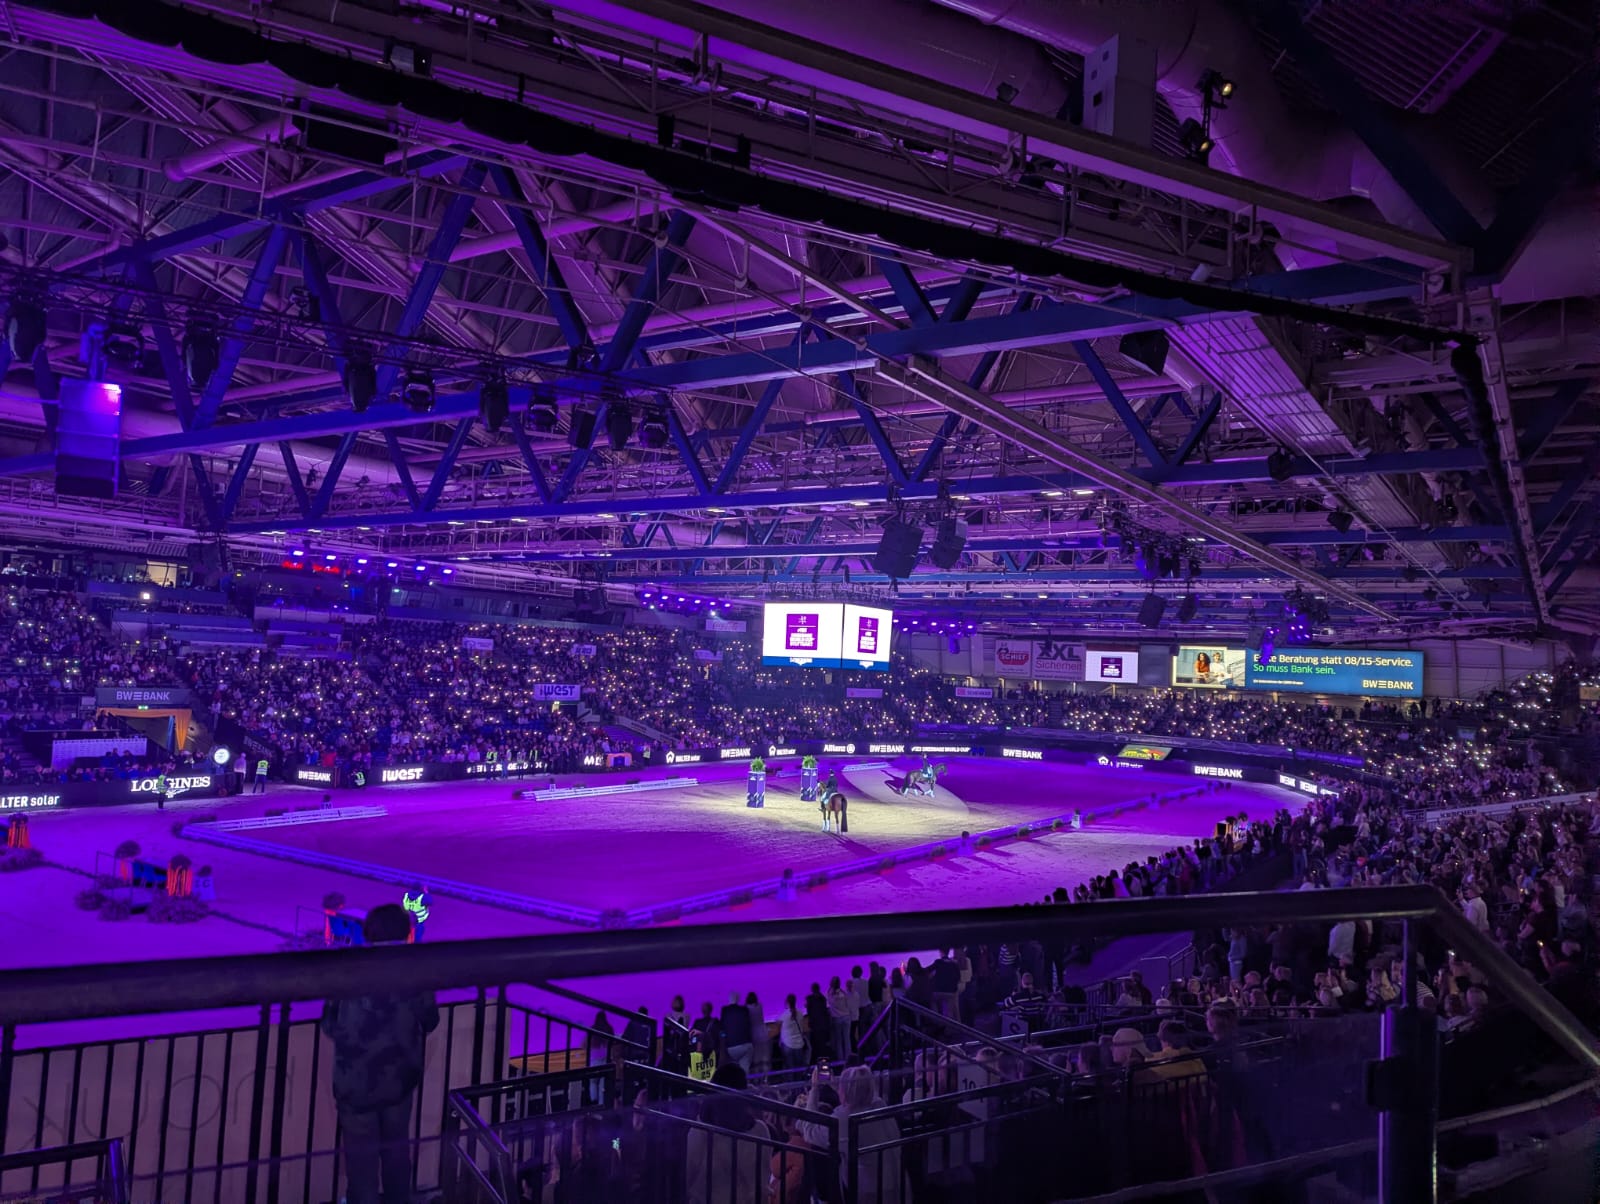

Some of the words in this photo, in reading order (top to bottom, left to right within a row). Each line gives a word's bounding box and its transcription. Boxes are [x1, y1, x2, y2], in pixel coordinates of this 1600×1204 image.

[1279, 654, 1319, 665] Beratung
[1321, 656, 1342, 665] statt
[1344, 656, 1414, 667] 08/15-Service.
[1253, 664, 1264, 672] So
[1266, 665, 1288, 673] muss
[1291, 665, 1313, 674] Bank
[1315, 666, 1336, 675] sein.
[30, 795, 60, 807] solar
[696, 1058, 714, 1072] FOTO
